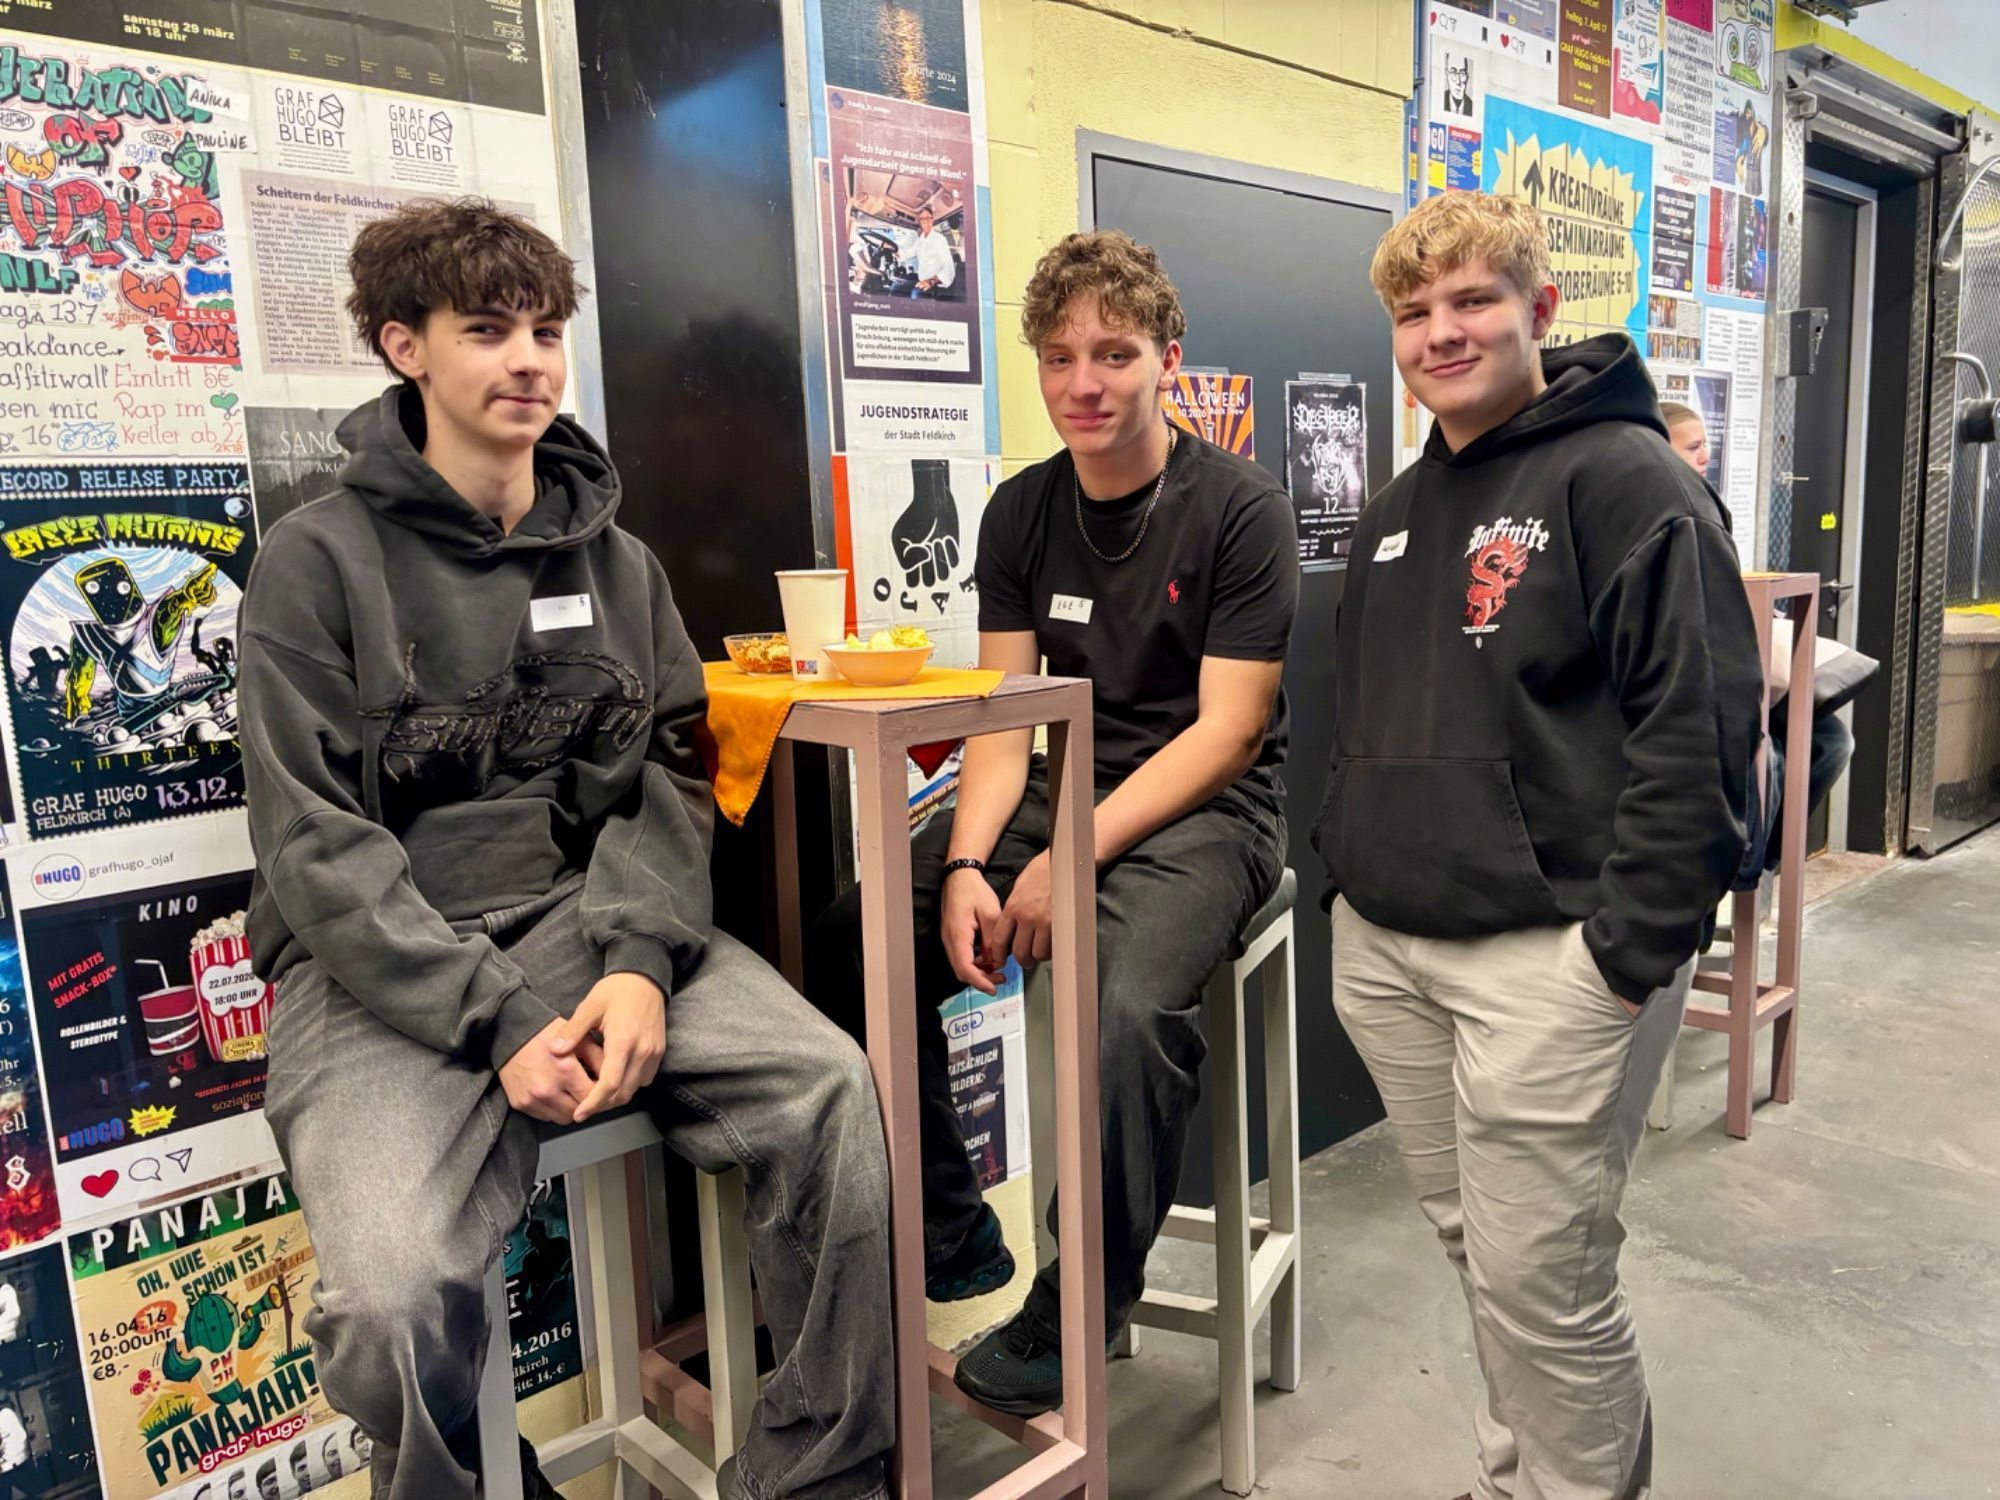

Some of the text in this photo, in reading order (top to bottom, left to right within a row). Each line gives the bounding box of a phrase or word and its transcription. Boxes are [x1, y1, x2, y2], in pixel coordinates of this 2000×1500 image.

[123, 13, 235, 40] samstag 29 märz
[124, 24, 141, 35] ab
[165, 31, 187, 42] uhr
[275, 87, 314, 109] GRAF
[277, 106, 316, 127] HUGO
[389, 104, 425, 124] GRAF
[279, 124, 345, 149] BLEIBT
[390, 123, 427, 143] HUGO
[392, 142, 453, 163] BLEIBT
[910, 151, 938, 163] schnell
[841, 154, 898, 171] Jugendarbeit
[899, 162, 925, 175] gegen
[256, 185, 312, 201] Scheitern
[314, 191, 331, 204] der
[334, 193, 395, 211] Feldkircher
[1549, 166, 1624, 226] KREATIVRÄUME
[1548, 217, 1625, 259] SEMINARRÄUME
[176, 309, 231, 320] HELLO
[1165, 390, 1245, 408] HALLOWEEN
[860, 404, 969, 421] JUGENDSTRATEGIE
[884, 429, 956, 441] der Stadt Feldkirch
[79, 469, 165, 489] RELEASE
[175, 468, 240, 487] PARTY
[1323, 496, 1339, 514] 12
[2, 513, 245, 559] LASER MUTANTS
[32, 792, 85, 816] GRAF
[96, 784, 148, 807] HUGO
[36, 808, 132, 831] FELDKIRCH (A)
[88, 852, 175, 879] grafhugo_ojaf
[139, 896, 198, 922] KINO
[47, 952, 105, 991] MIT GRATIS
[240, 988, 258, 1000] UHR
[60, 1017, 118, 1038] ROLLENBILDER
[70, 1031, 118, 1049] STEREOTYPE
[69, 1117, 125, 1149] HUGO
[137, 1248, 206, 1298] OH, WIE
[182, 1243, 268, 1303] SCHÖN IST
[88, 1308, 167, 1346] 16.04.16
[93, 1362, 130, 1382] €8,-
[147, 1360, 320, 1487] PANAJAH!
[202, 1413, 303, 1472] graf hugo
